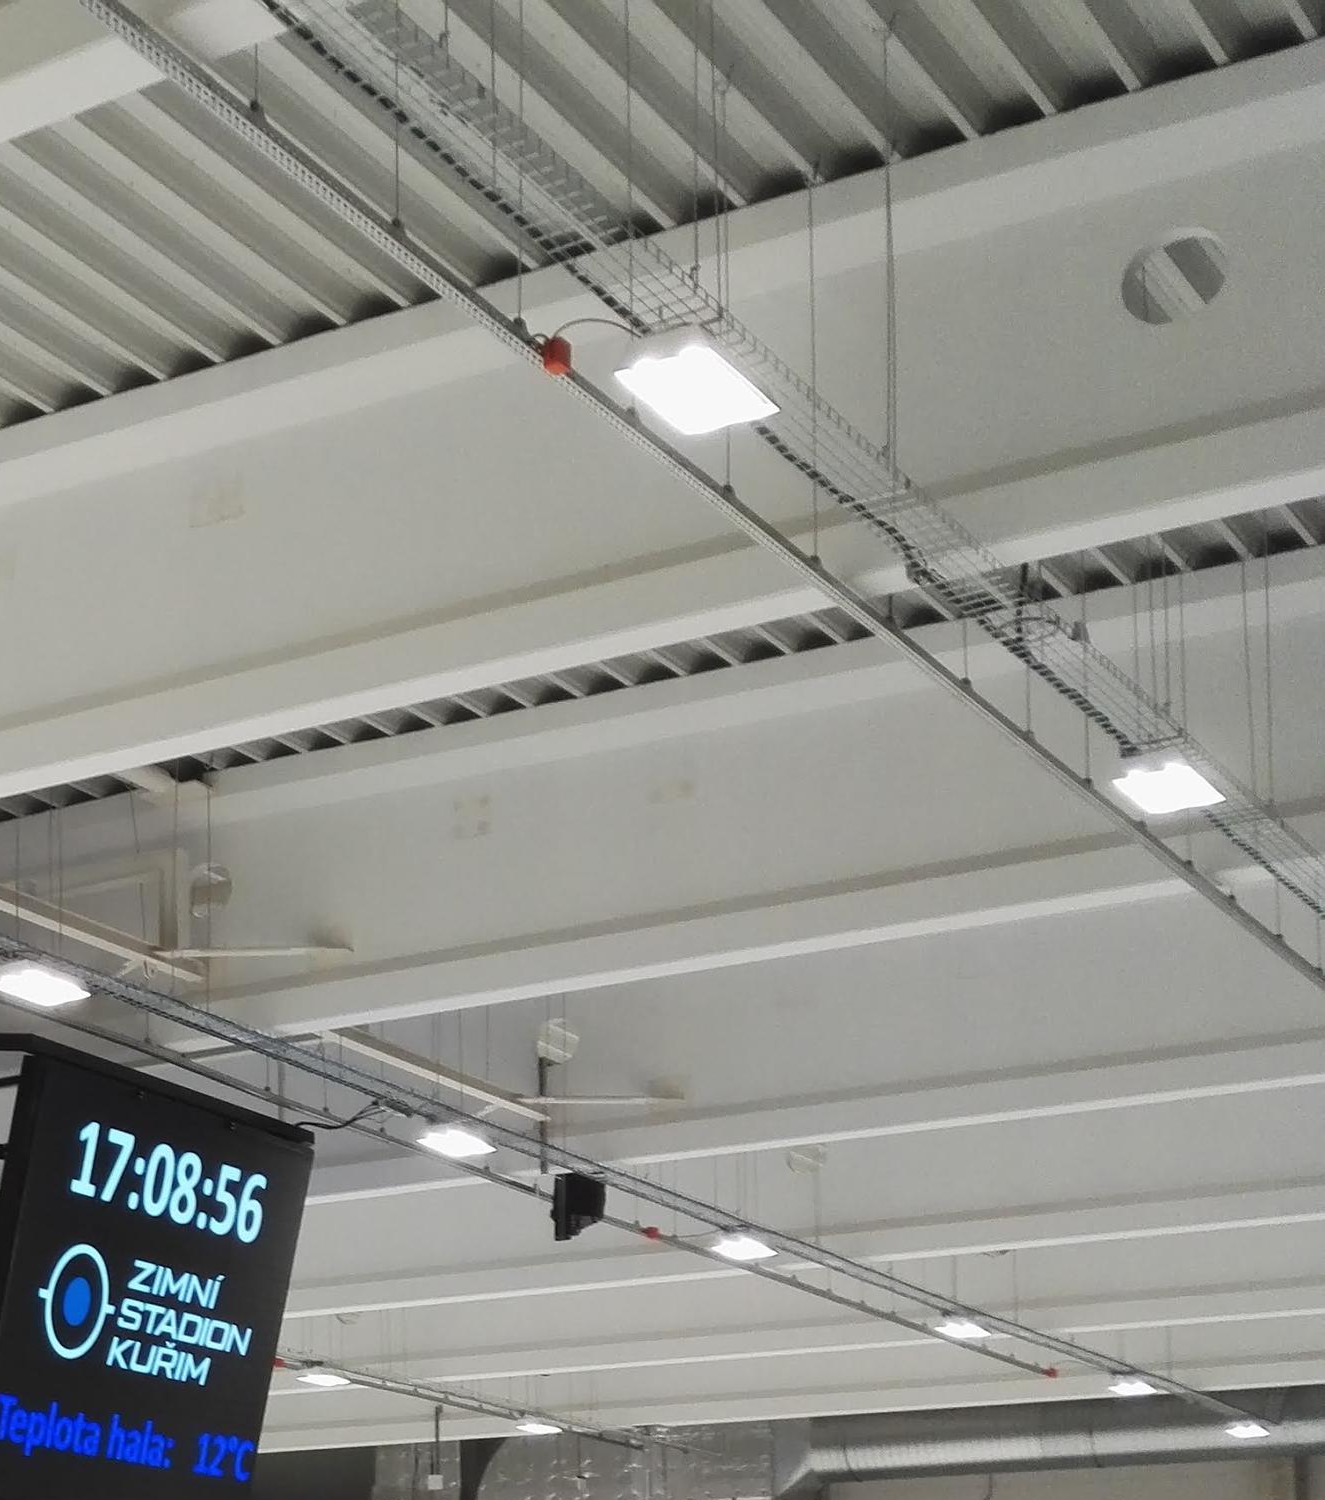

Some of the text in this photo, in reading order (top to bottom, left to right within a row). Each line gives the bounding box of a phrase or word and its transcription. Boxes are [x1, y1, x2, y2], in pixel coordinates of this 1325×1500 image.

[70, 1121, 268, 1243] 17:08:56
[127, 1259, 225, 1310] ZIMNÍ
[116, 1298, 252, 1356] STADION
[105, 1337, 212, 1386] KUŘIM
[106, 1413, 176, 1470] hala:
[192, 1432, 255, 1483] 12°C
